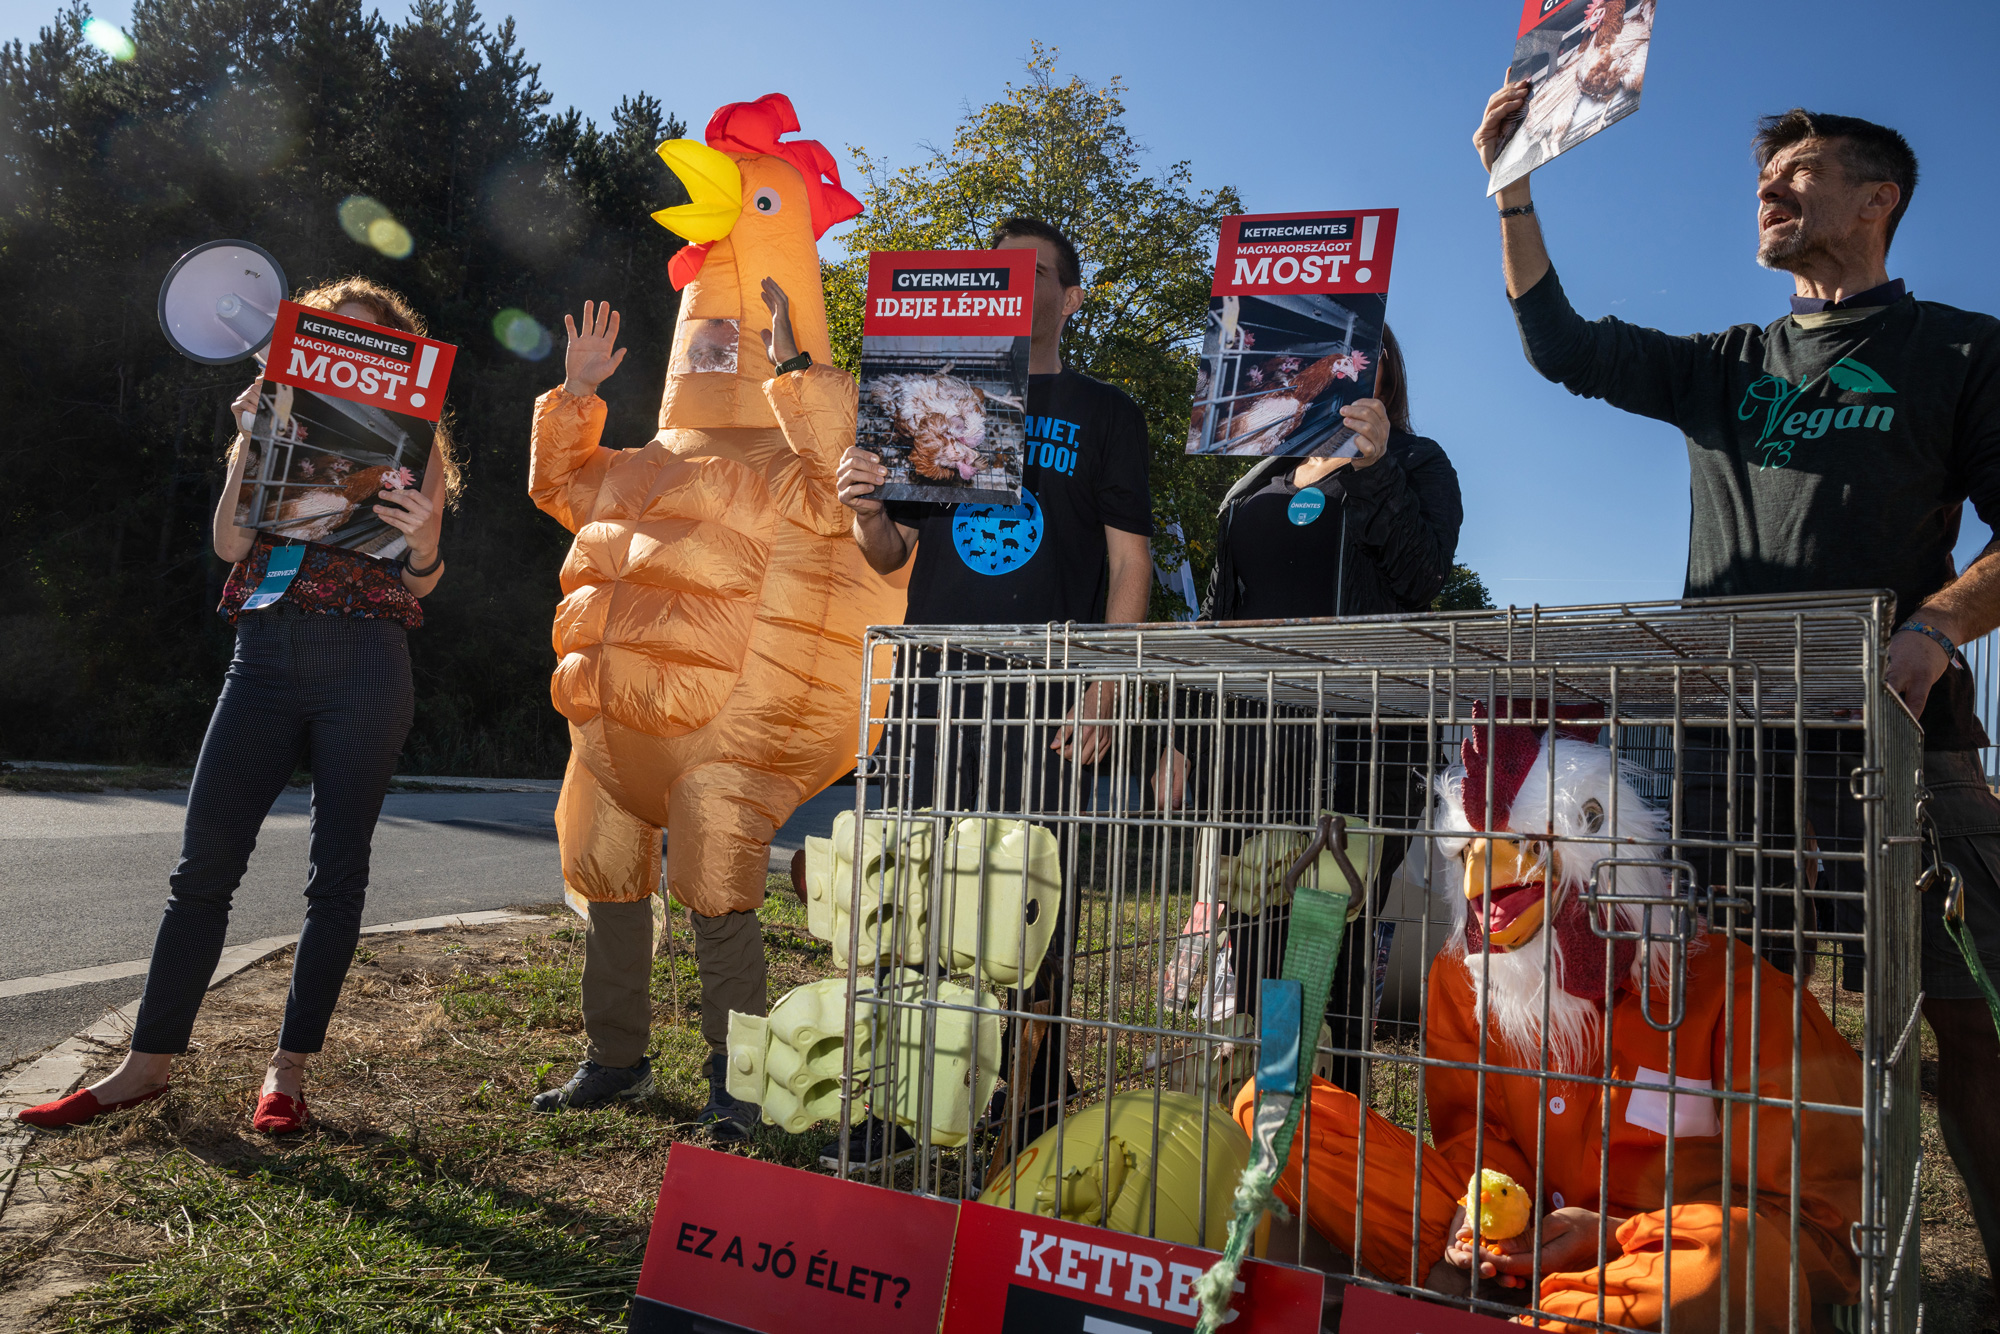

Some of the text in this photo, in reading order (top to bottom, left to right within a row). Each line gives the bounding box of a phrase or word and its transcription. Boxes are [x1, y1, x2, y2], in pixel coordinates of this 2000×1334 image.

[1244, 224, 1347, 238] KETRECMENTES
[1237, 241, 1352, 255] MAGYARORSZÁGOT
[898, 272, 1000, 288] GYERMELYI,
[875, 292, 1022, 319] IDEJE LÉPNI!
[303, 320, 408, 356] KETRECMENTES
[293, 336, 411, 374] MAGYARORSZÁGOT
[1738, 374, 1895, 447] Vegan
[1025, 415, 1081, 448] ANET,
[1026, 441, 1078, 477] TOO!
[266, 567, 297, 578] SZERVEZŐ
[675, 1222, 911, 1310] EZ A JÓ ÉLET?
